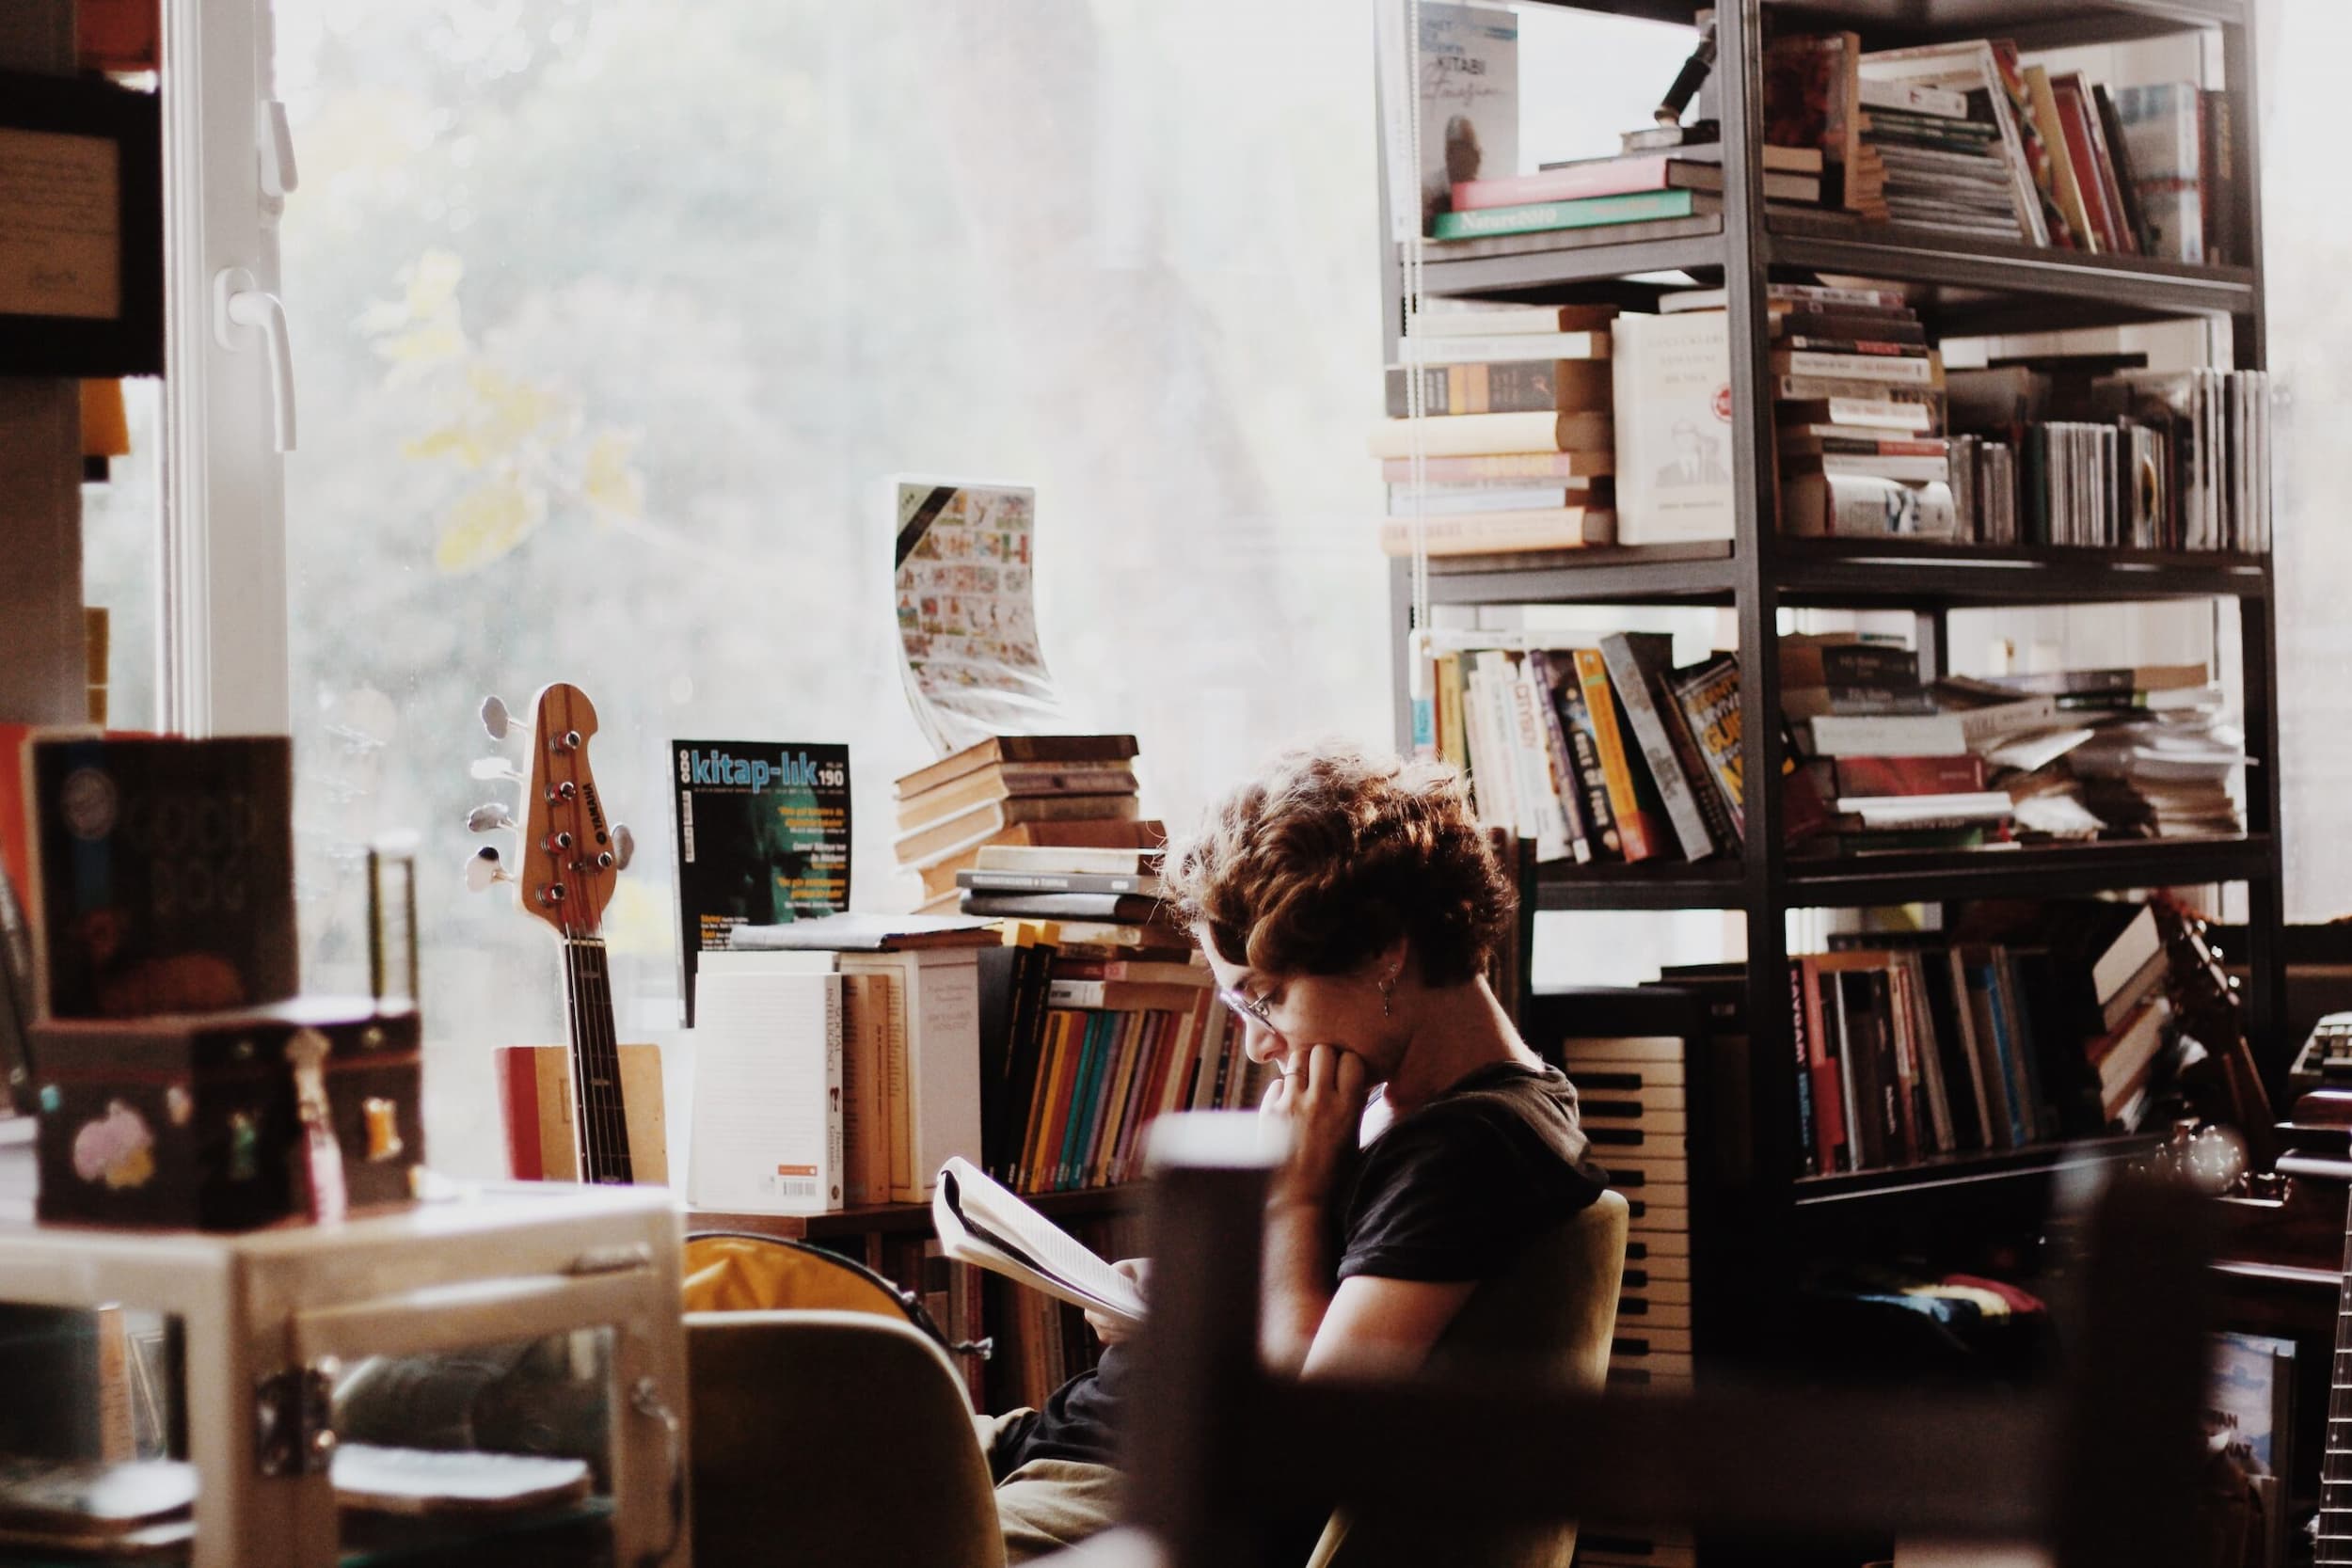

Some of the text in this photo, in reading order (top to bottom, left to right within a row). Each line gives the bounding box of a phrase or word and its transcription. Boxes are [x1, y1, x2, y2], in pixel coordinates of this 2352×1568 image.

[691, 750, 818, 794] kitap-lık
[818, 769, 844, 786] 190
[582, 783, 603, 832] YAMAHA
